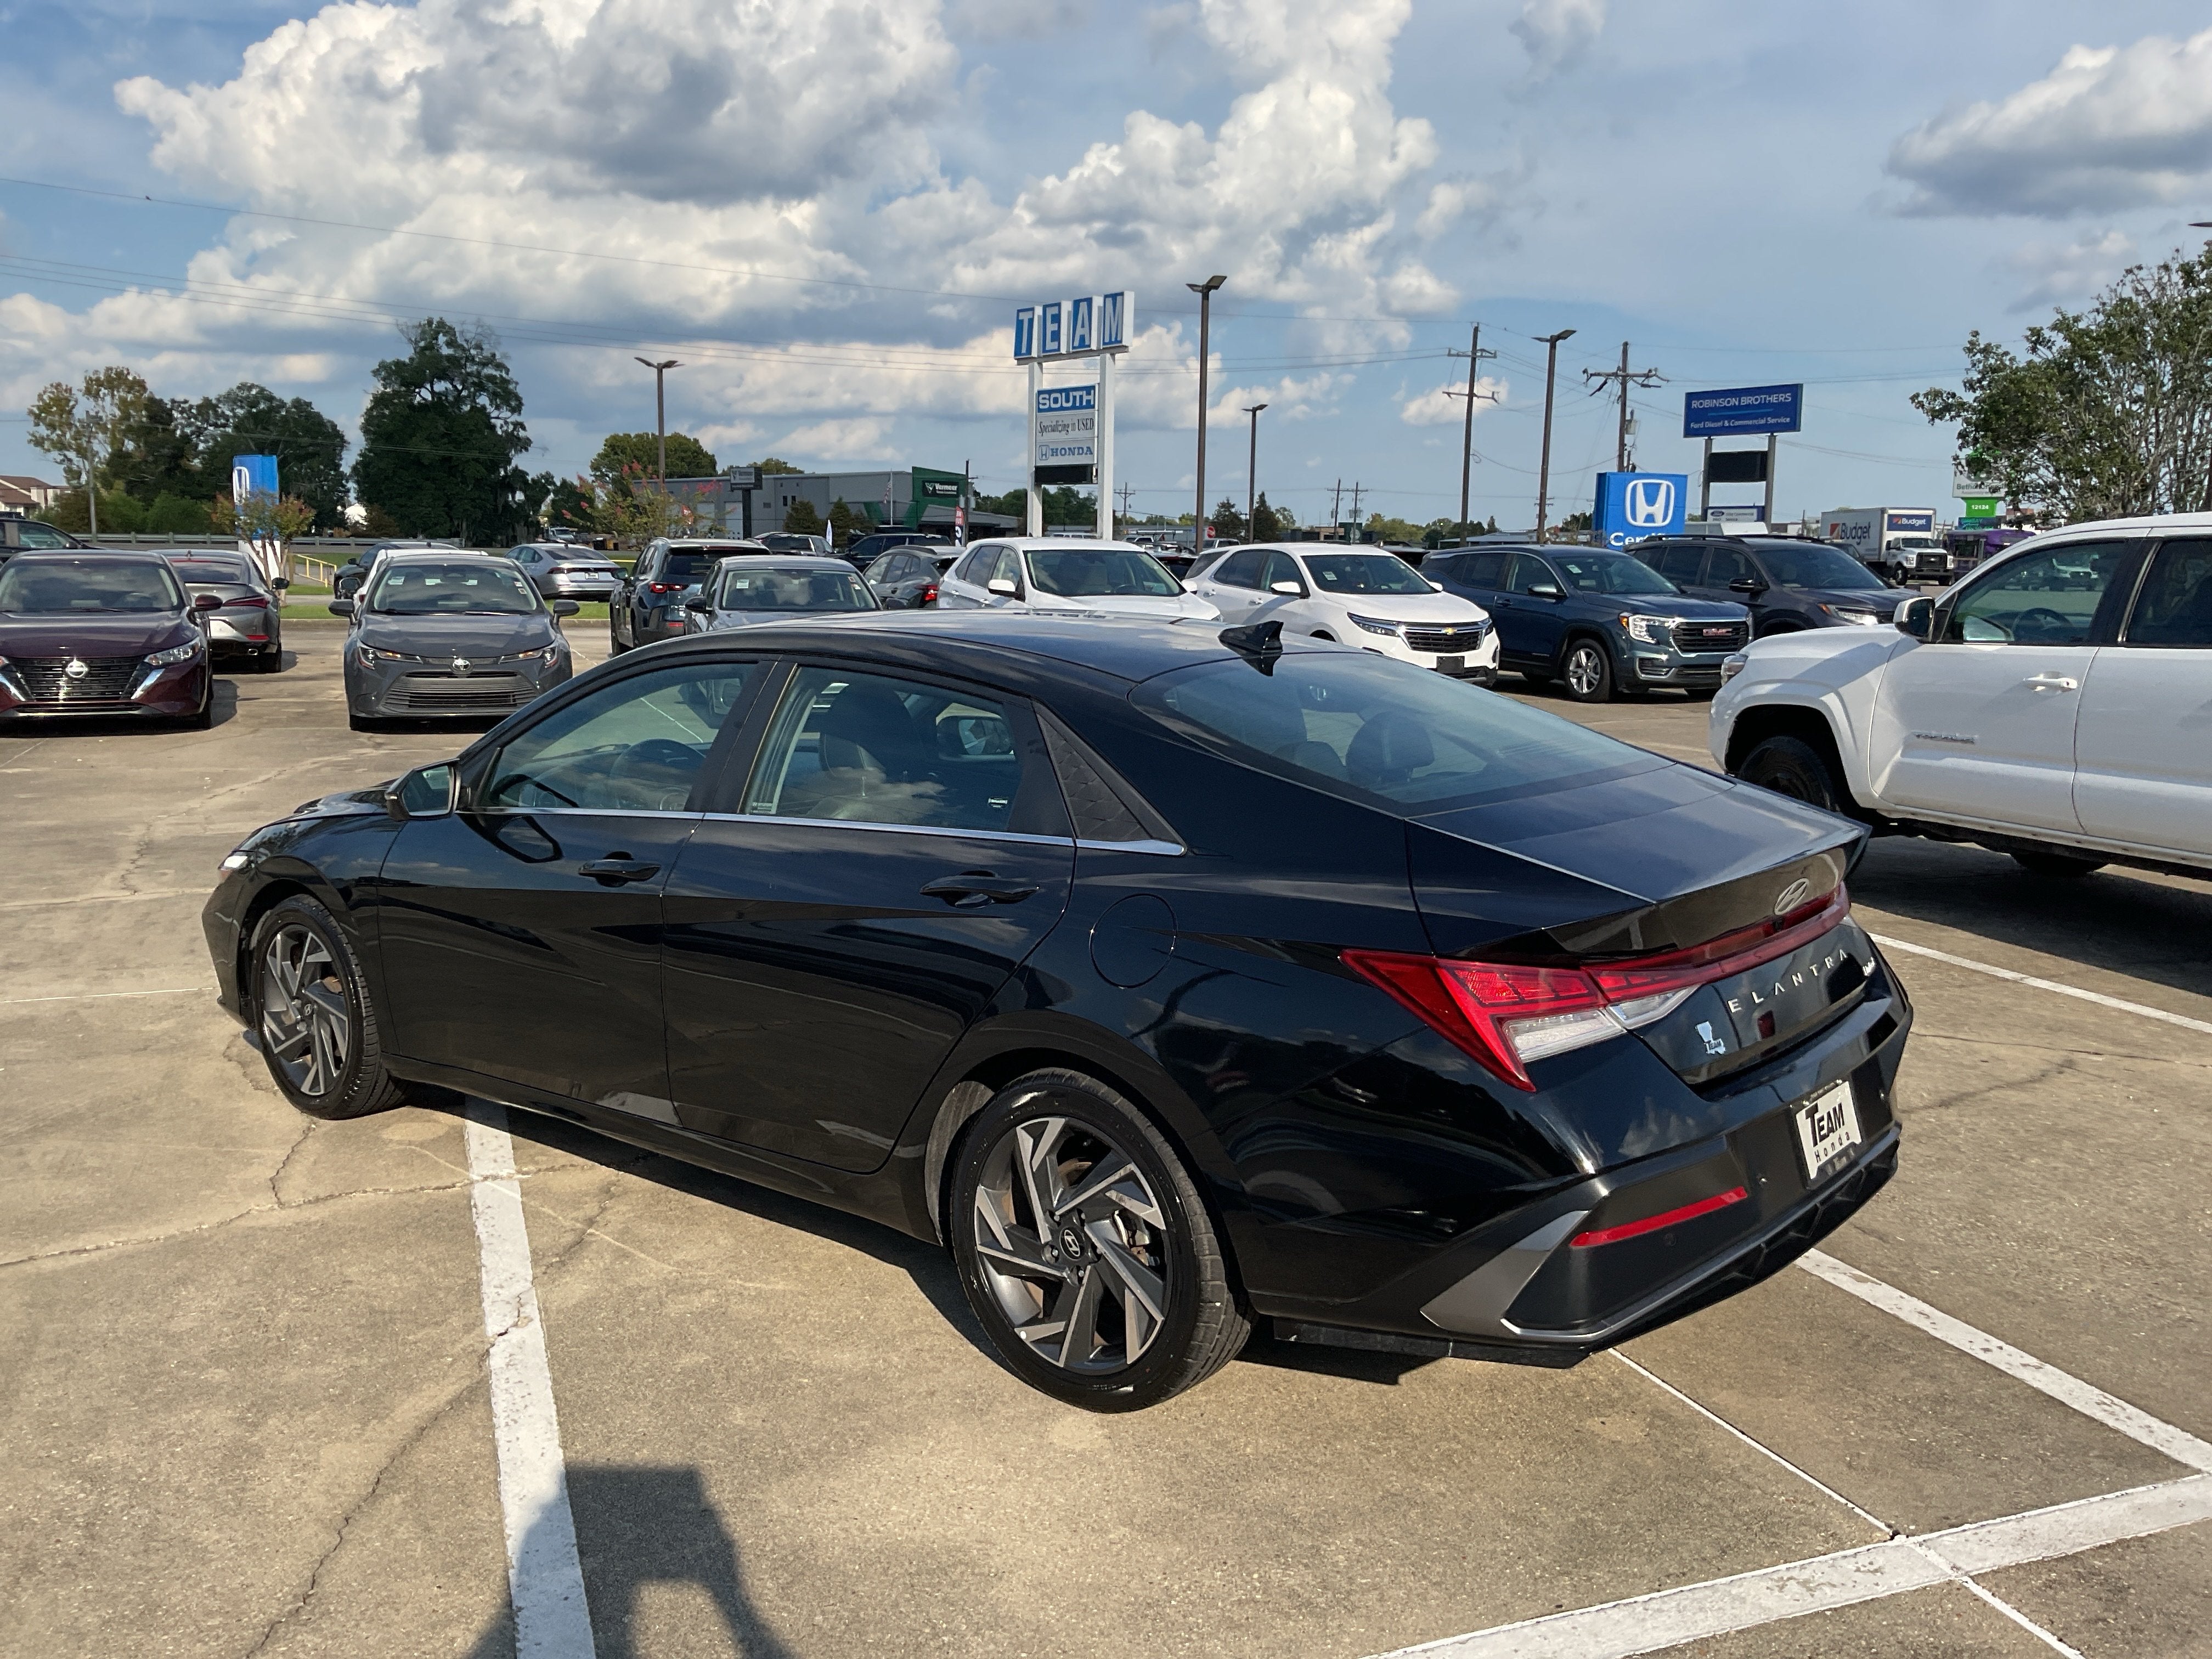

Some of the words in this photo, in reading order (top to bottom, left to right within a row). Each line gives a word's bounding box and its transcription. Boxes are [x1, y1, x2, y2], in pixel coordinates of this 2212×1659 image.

[1019, 295, 1124, 353] TEAM
[1039, 390, 1094, 409] SOUTH
[1691, 397, 1739, 409] ROBINSON
[1740, 393, 1791, 405] BROTHERS
[1039, 420, 1069, 437] Specializing
[1070, 419, 1076, 433] in
[1077, 417, 1094, 431] USED
[1730, 417, 1766, 426] Commercial
[1050, 447, 1093, 456] HONDA
[1901, 517, 1926, 526] Budget
[1840, 522, 1871, 545] Budget
[1728, 949, 1848, 1013] ELANTRA
[1805, 1102, 1845, 1148] TEAM
[1814, 1131, 1850, 1163] Honda
